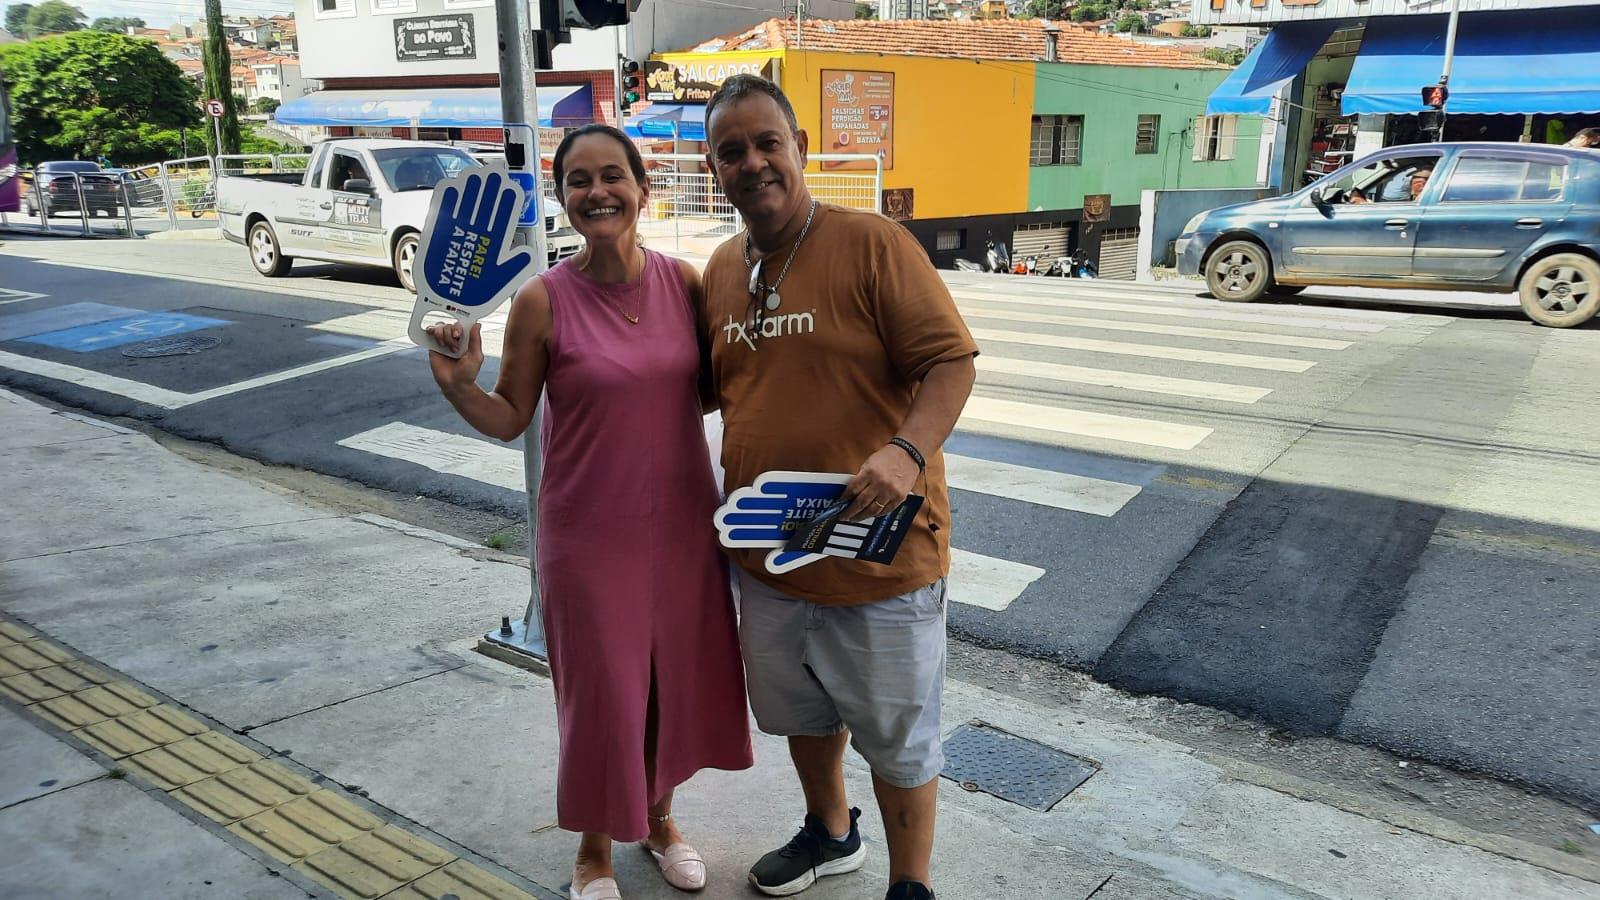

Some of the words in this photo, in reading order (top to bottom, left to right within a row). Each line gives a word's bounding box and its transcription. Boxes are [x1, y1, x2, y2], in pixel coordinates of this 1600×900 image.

[451, 225, 465, 237] A
[438, 240, 462, 286] FAIXA
[449, 231, 478, 297] RESPEITE
[470, 236, 491, 280] PARE!
